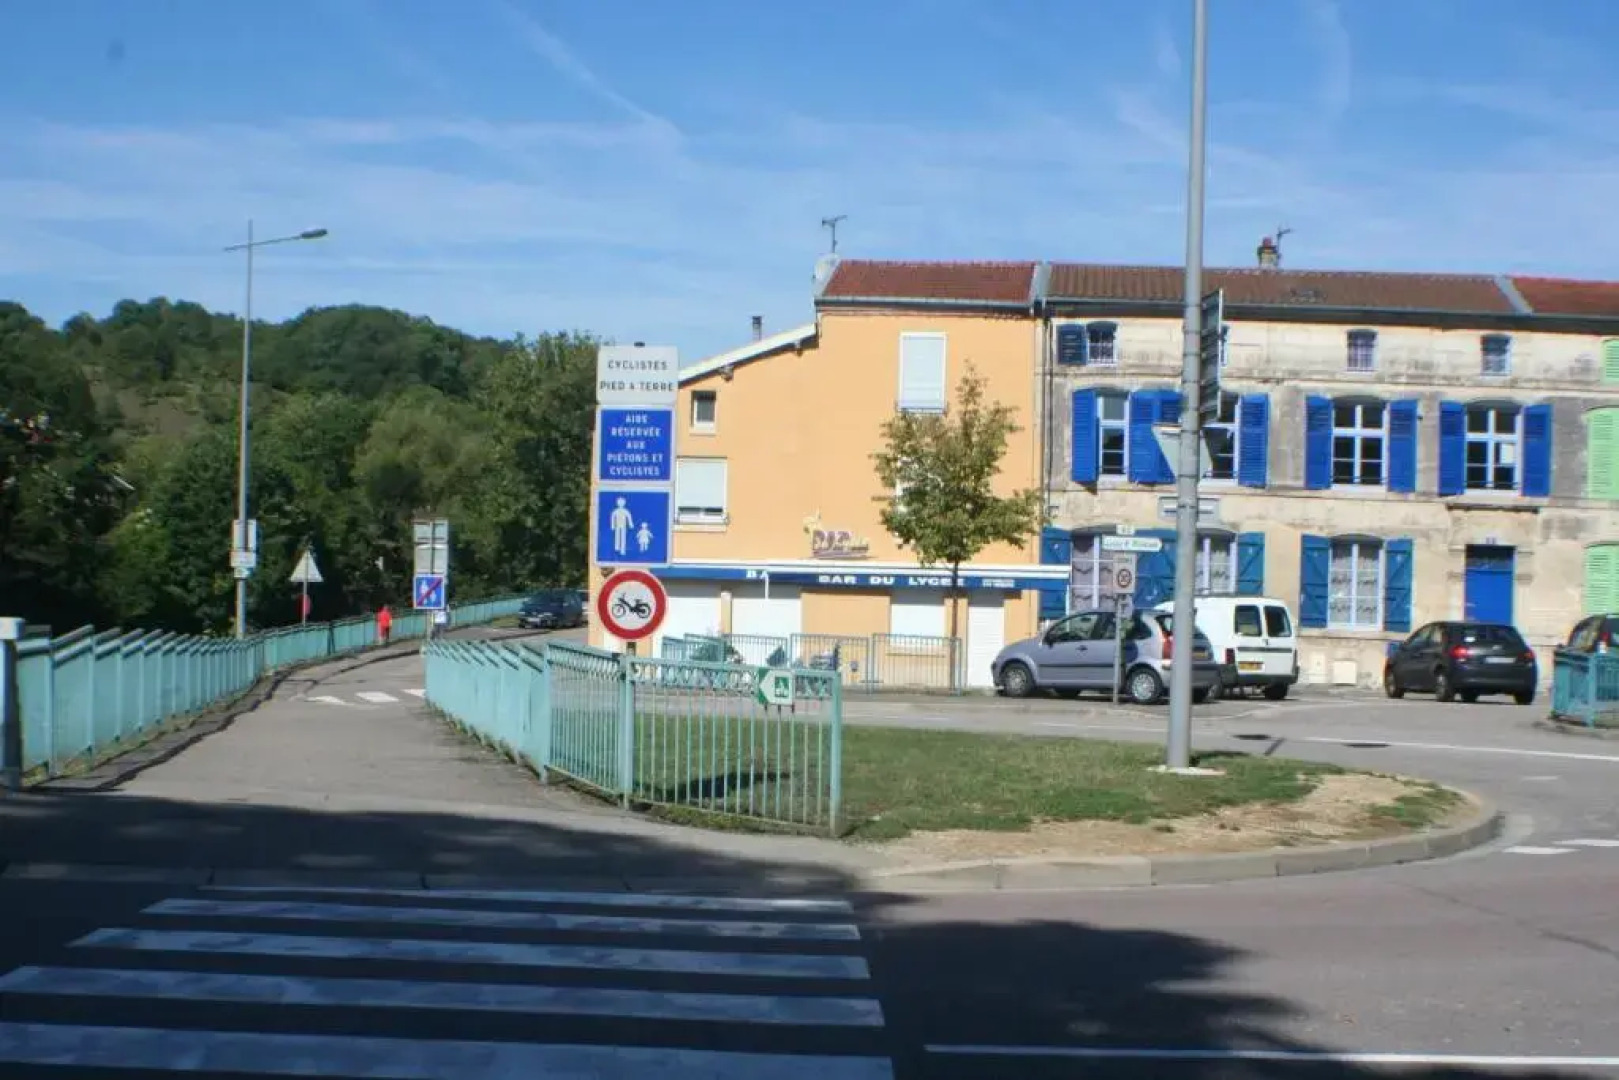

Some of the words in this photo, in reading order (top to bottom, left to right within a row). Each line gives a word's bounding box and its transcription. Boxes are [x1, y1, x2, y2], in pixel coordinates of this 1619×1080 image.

[608, 360, 667, 370] CYCLISTES
[600, 381, 625, 390] PIED
[640, 381, 673, 392] TERRE
[625, 440, 646, 450] AUX
[652, 452, 664, 463] ET
[609, 465, 660, 477] CYCLISTES
[818, 574, 857, 584] BAR
[869, 575, 896, 585] DU
